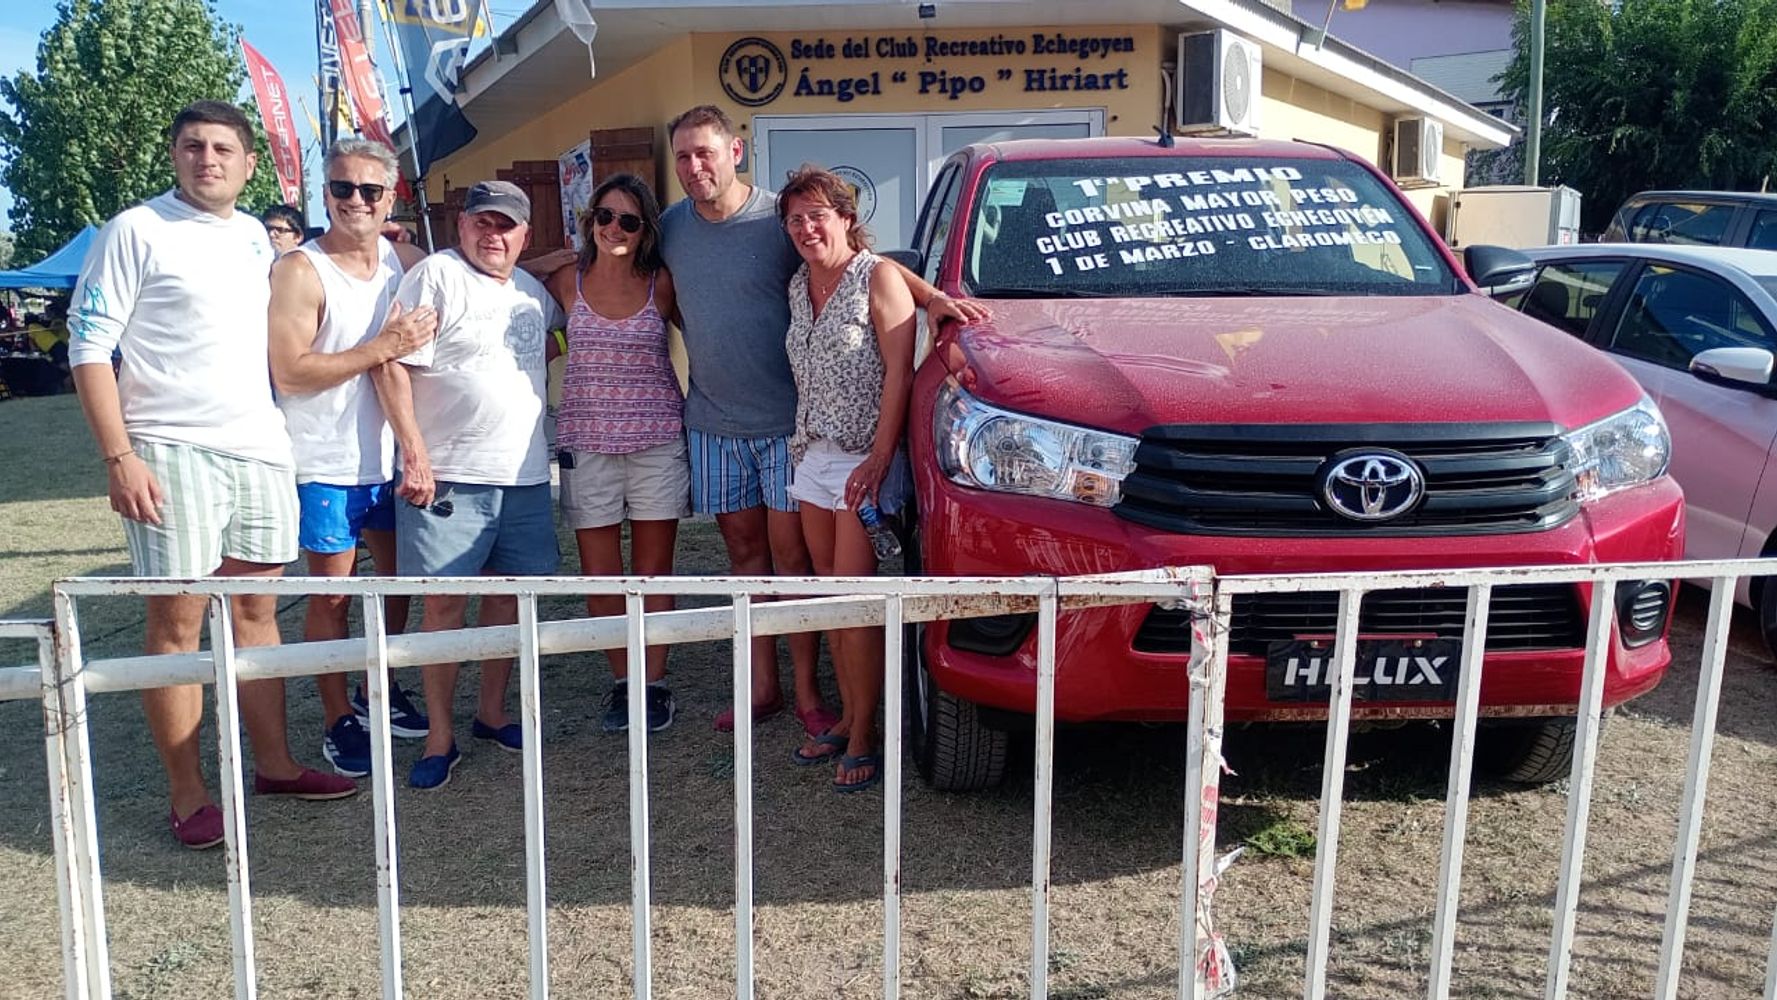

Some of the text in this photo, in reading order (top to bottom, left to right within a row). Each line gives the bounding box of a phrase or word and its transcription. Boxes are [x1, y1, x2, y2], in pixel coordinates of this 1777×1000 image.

[791, 33, 1134, 60] Sede del Club Recreativo Echegoyen
[794, 68, 881, 101] Ángel
[919, 70, 985, 99] Pipo
[1024, 68, 1128, 91] Hiriart
[1123, 168, 1302, 191] PREMIO
[1045, 188, 1358, 228] CORVINA MAYOR PESO
[1036, 207, 1396, 256] CLUB RECREATIVO ECHEGOYEN
[1045, 256, 1065, 276] 1
[1077, 252, 1109, 271] DE
[1119, 239, 1217, 265] MARZO
[1248, 230, 1402, 250] CLAROMECO
